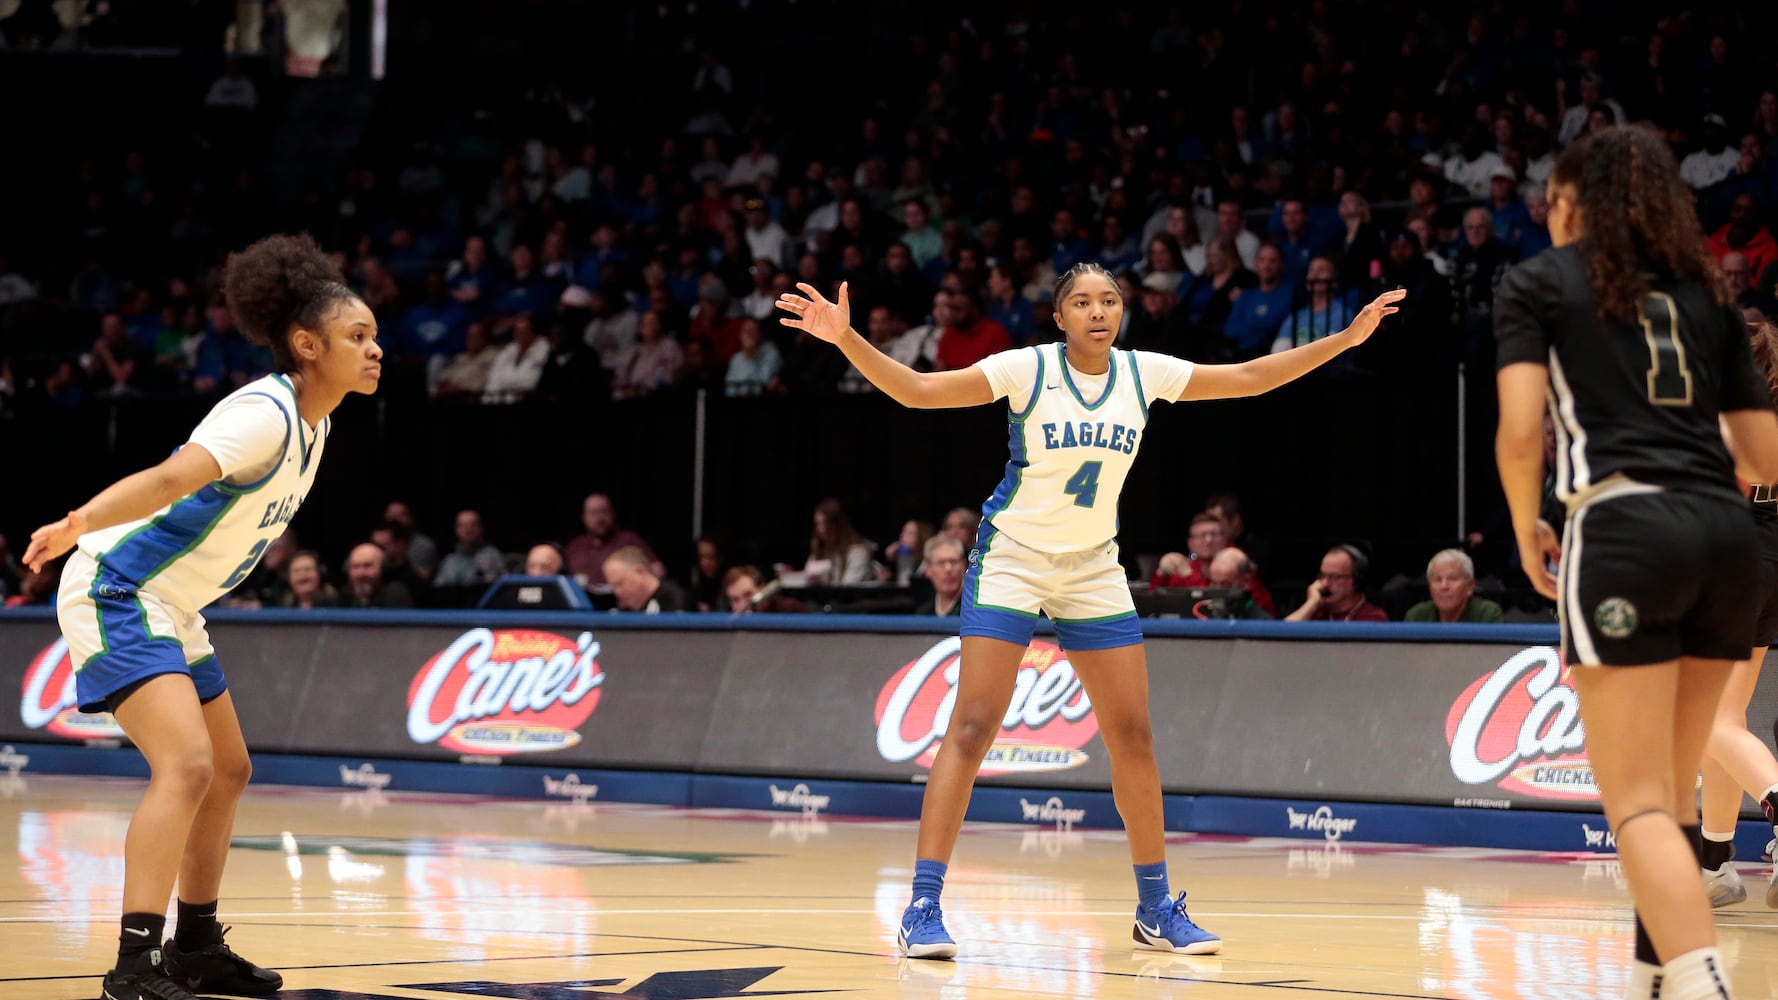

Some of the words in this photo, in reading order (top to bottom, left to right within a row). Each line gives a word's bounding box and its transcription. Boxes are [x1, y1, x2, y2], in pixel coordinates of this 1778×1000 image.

[1635, 290, 1693, 406] 1
[1042, 421, 1137, 455] EAGLES
[1064, 460, 1103, 508] 4
[407, 627, 605, 744] Cane's
[1535, 766, 1595, 786] CHICKE
[1307, 805, 1358, 841] Kroger
